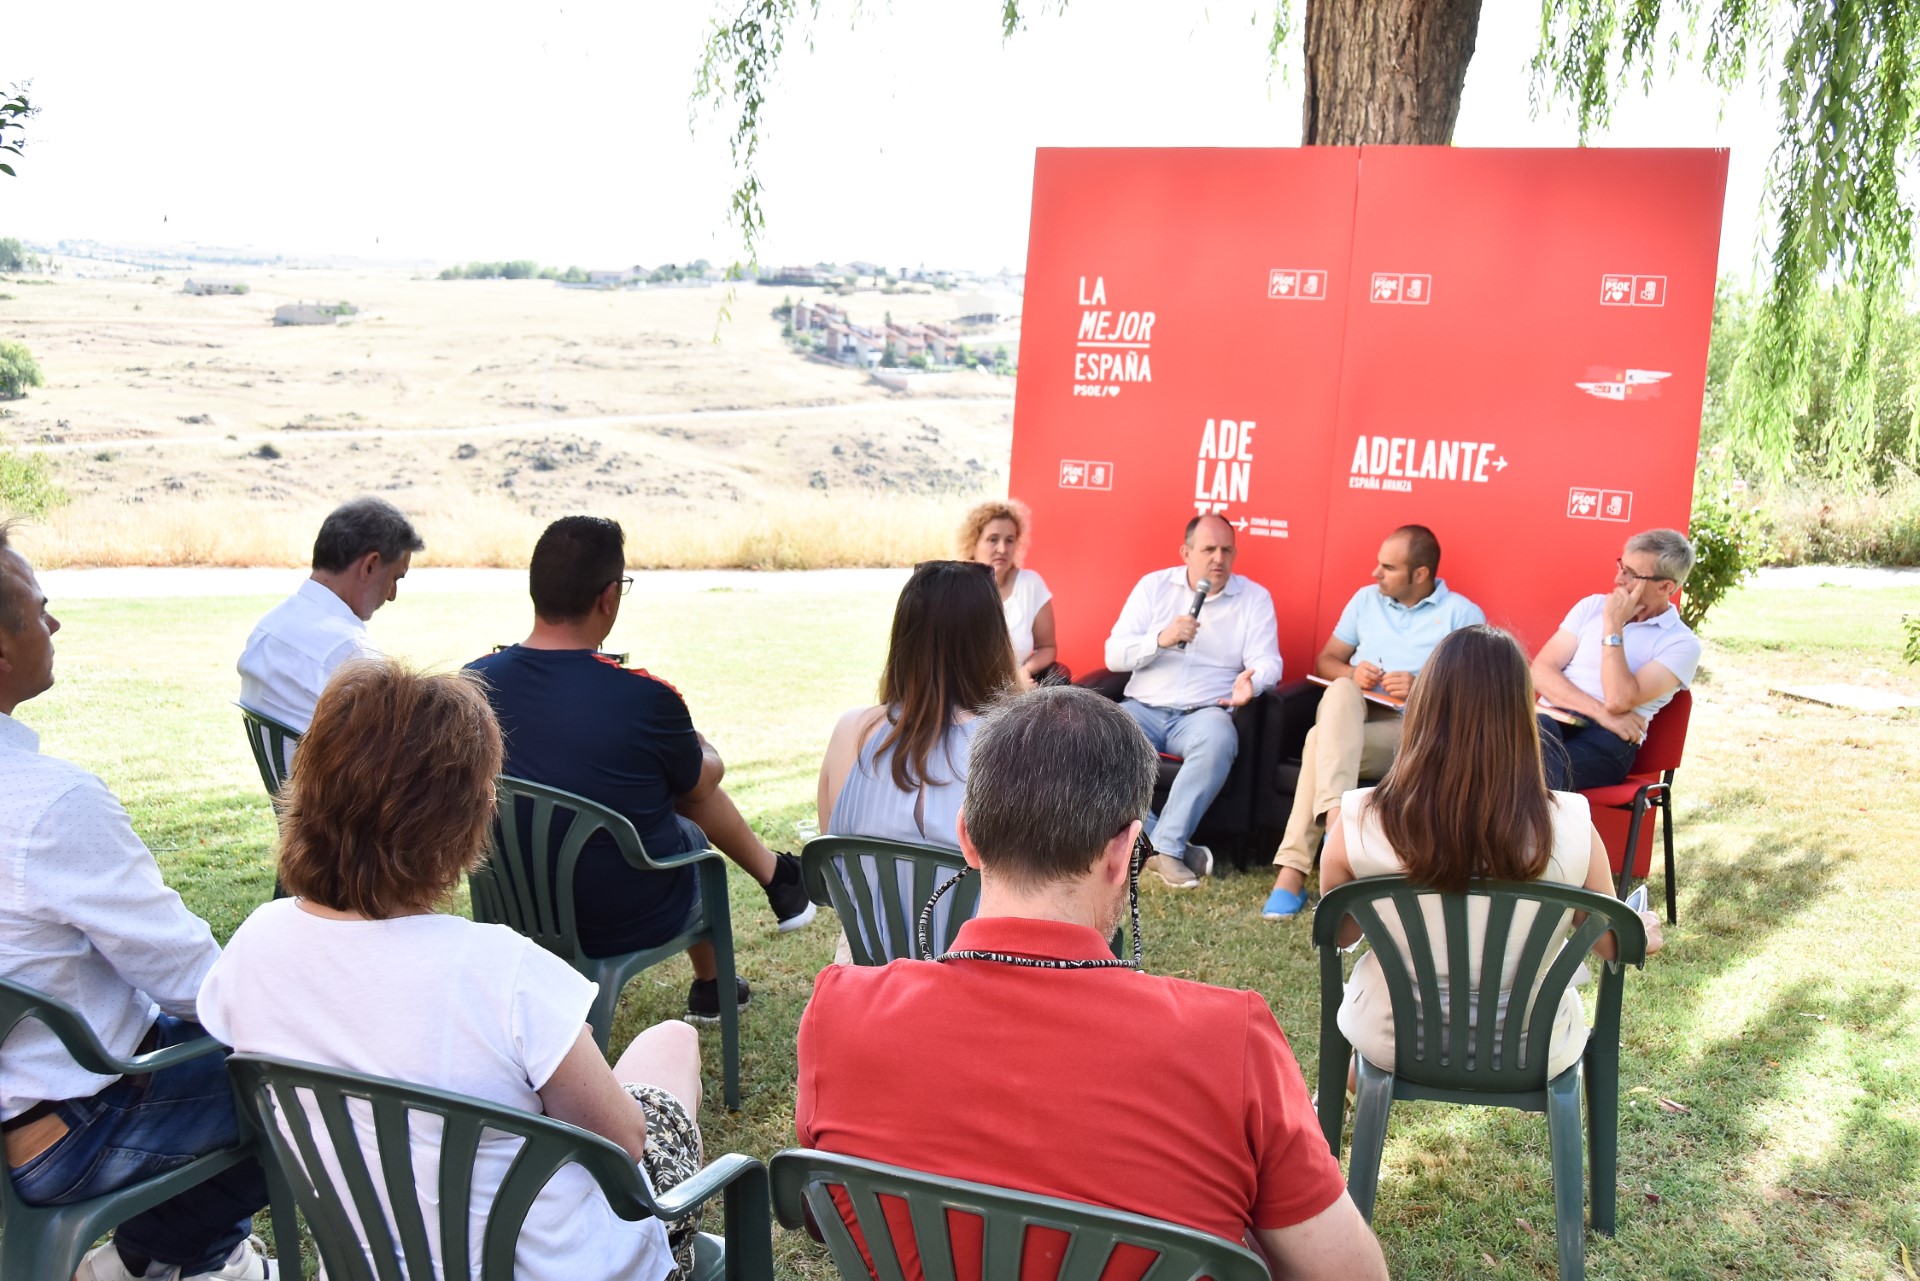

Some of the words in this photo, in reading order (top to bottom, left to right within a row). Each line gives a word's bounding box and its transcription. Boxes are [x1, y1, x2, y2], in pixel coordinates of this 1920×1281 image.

[1078, 276, 1106, 306] LA
[1605, 281, 1630, 292] PSOE
[1077, 310, 1156, 341] MEJOR
[1074, 350, 1152, 382] ESPAÑA
[1198, 418, 1257, 462] ADE
[1350, 435, 1496, 483] ADELANTE
[1195, 459, 1251, 503] LAN
[1348, 475, 1380, 490] ESPAÑA
[1381, 478, 1412, 493] AVANZA
[1571, 494, 1597, 506] PSOE
